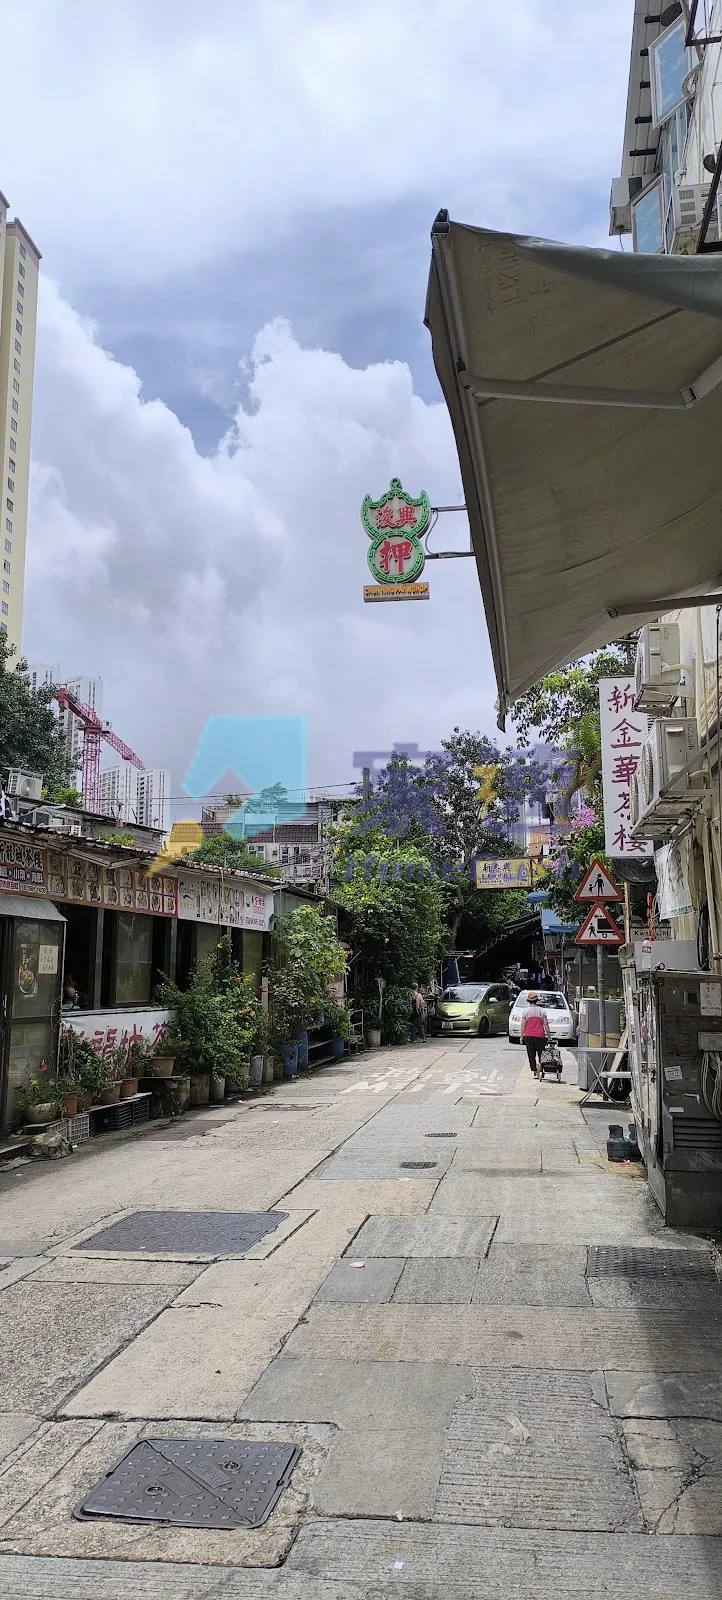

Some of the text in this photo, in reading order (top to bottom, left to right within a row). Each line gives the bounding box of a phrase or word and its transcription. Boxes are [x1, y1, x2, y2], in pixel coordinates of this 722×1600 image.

[378, 539, 413, 575] 押
[364, 586, 380, 595] CHUN
[380, 585, 395, 594] HING
